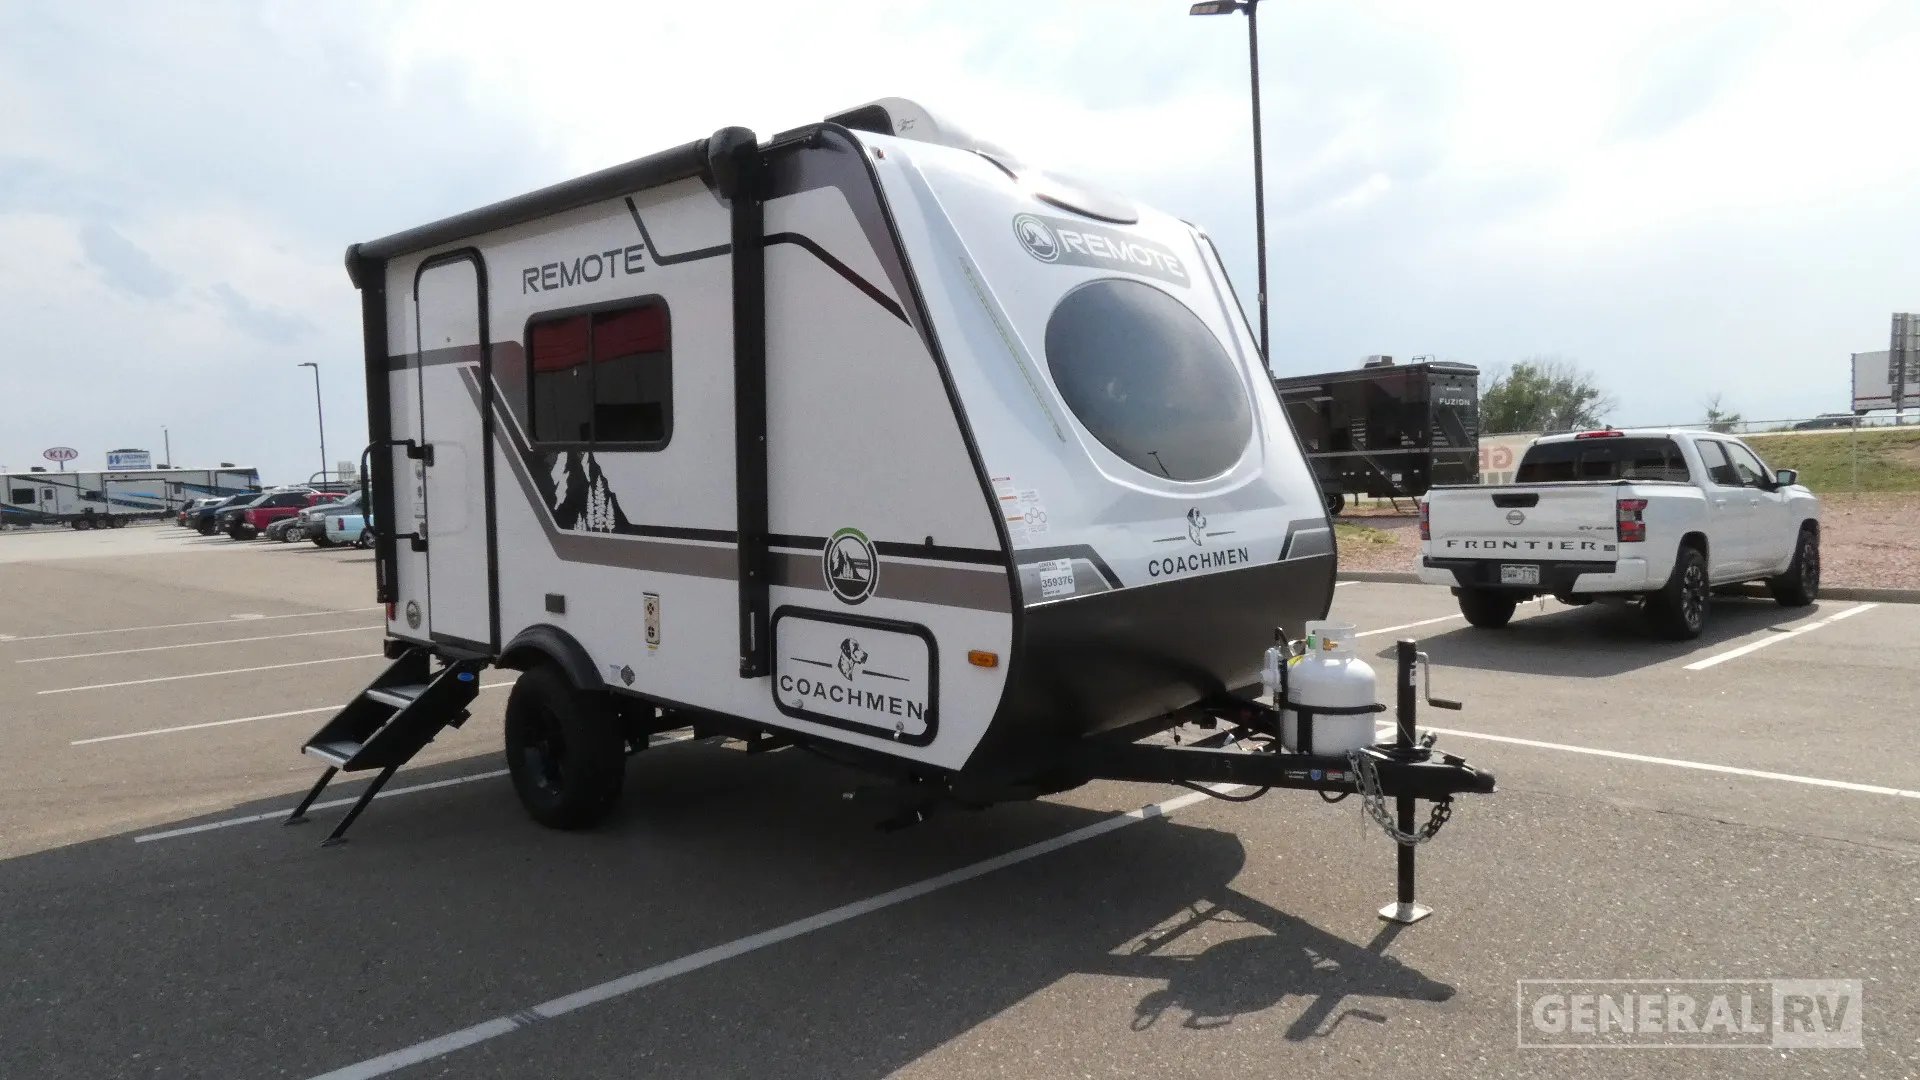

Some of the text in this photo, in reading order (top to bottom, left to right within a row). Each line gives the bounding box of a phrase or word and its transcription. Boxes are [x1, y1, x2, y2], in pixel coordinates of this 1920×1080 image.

[1057, 230, 1186, 277] REMOTE
[523, 244, 645, 294] REMOTE
[1438, 398, 1471, 406] FUZION
[49, 450, 73, 459] KIA
[1446, 540, 1597, 551] FRONTIER
[1148, 546, 1250, 577] COACHMEN
[1042, 575, 1074, 588] 359376
[780, 676, 923, 720] COACHMEN
